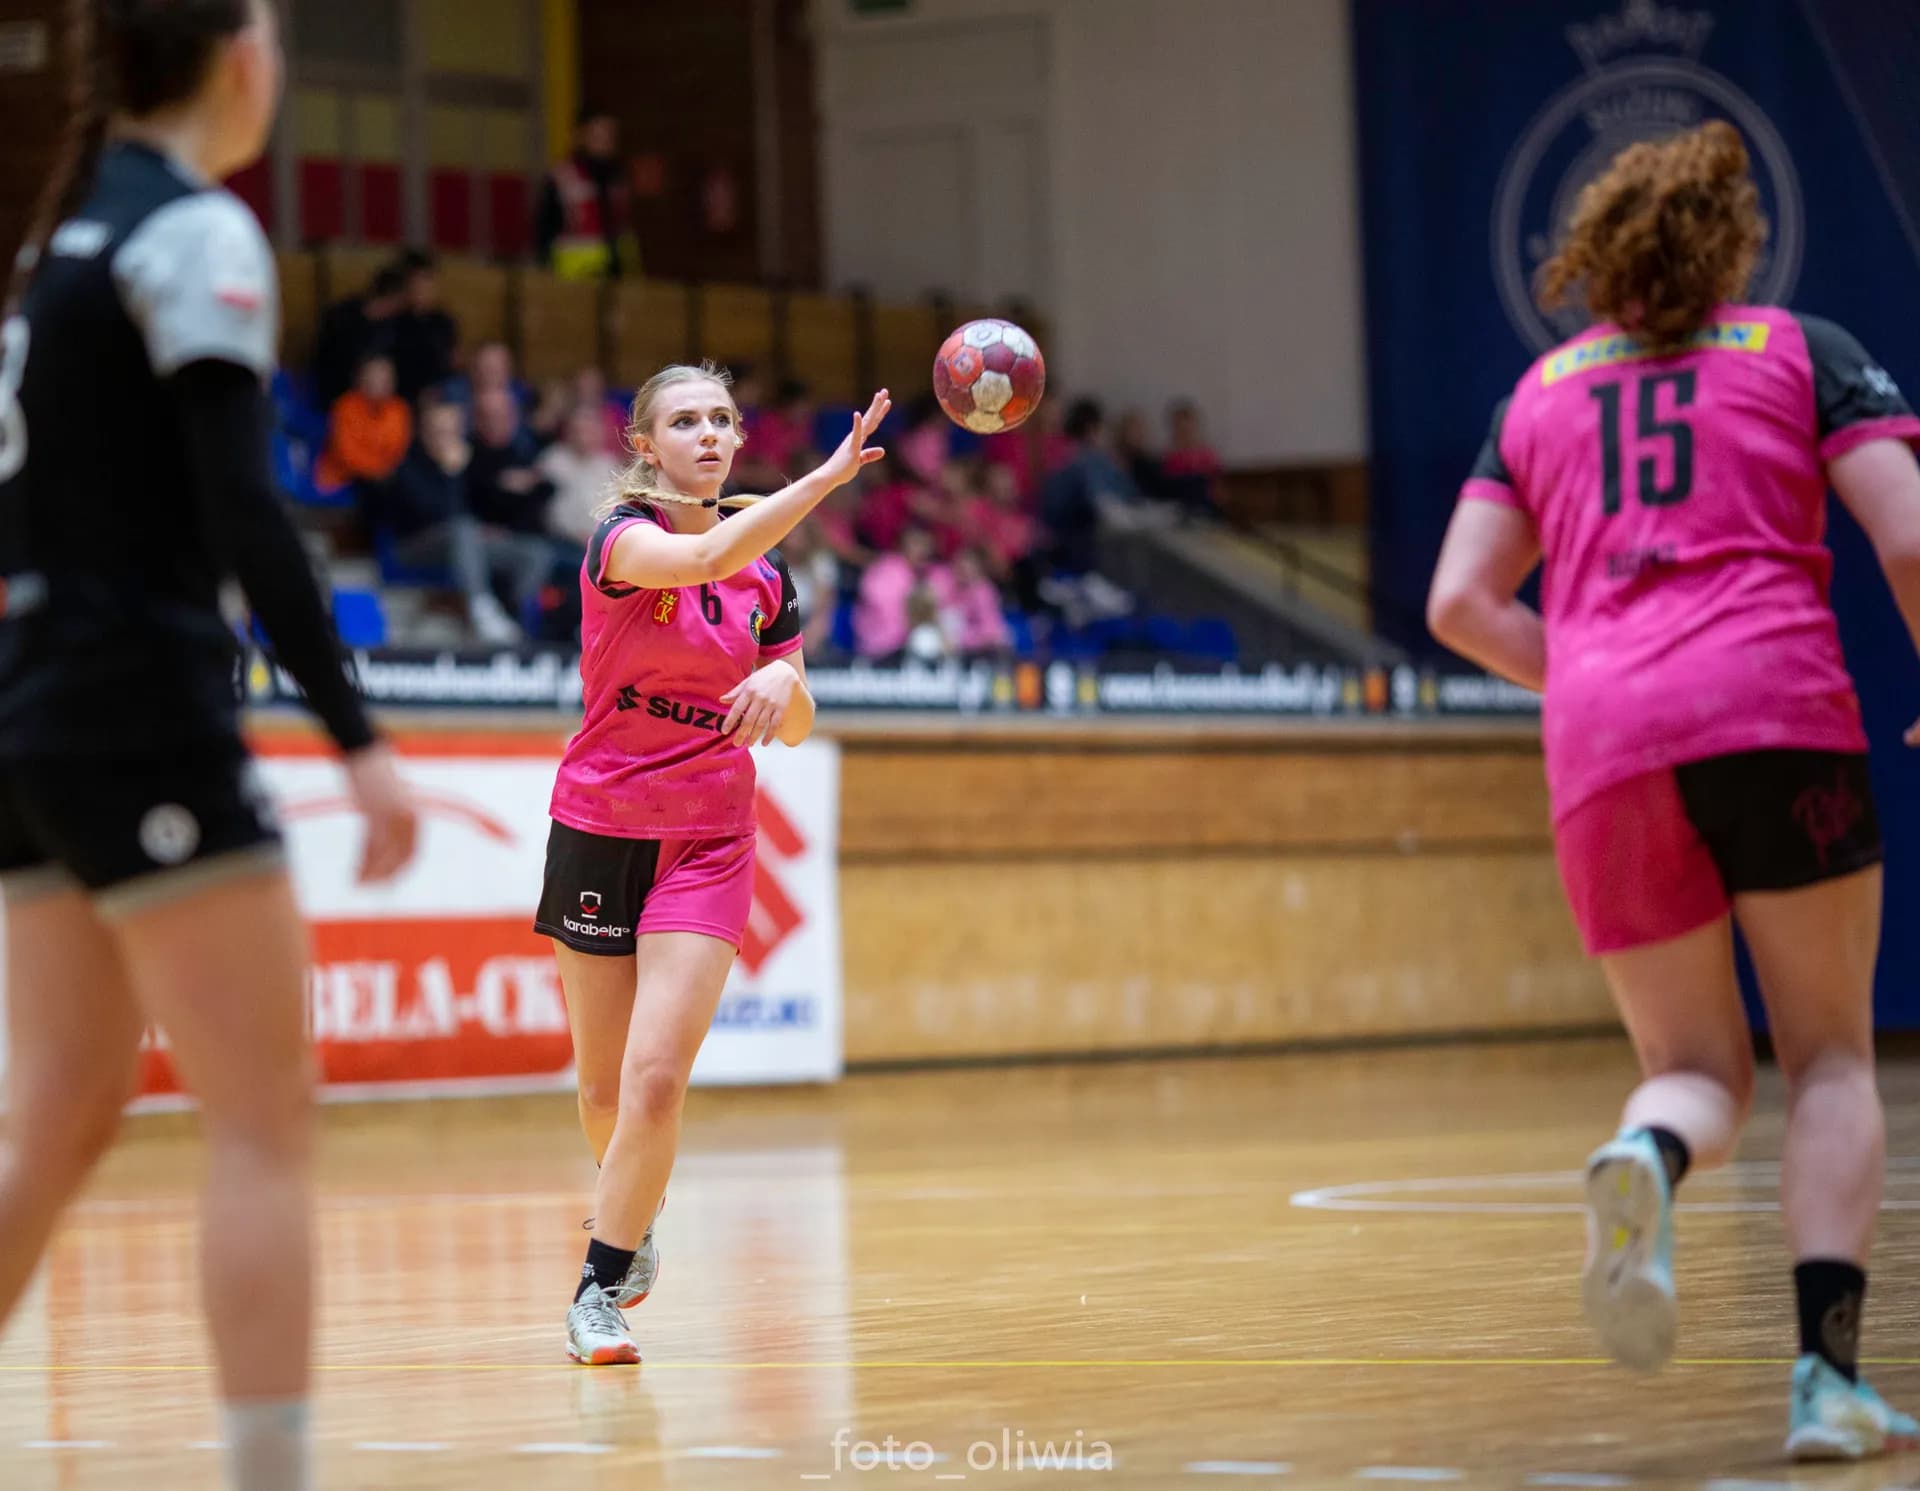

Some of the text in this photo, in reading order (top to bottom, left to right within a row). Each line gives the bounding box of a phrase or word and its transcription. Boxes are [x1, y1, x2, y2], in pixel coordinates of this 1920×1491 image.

[1589, 369, 1697, 517] 15
[654, 601, 673, 624] CK
[700, 581, 722, 626] 6
[787, 598, 799, 613] PR
[563, 915, 622, 938] karabela
[303, 955, 570, 1042] BELA-CK
